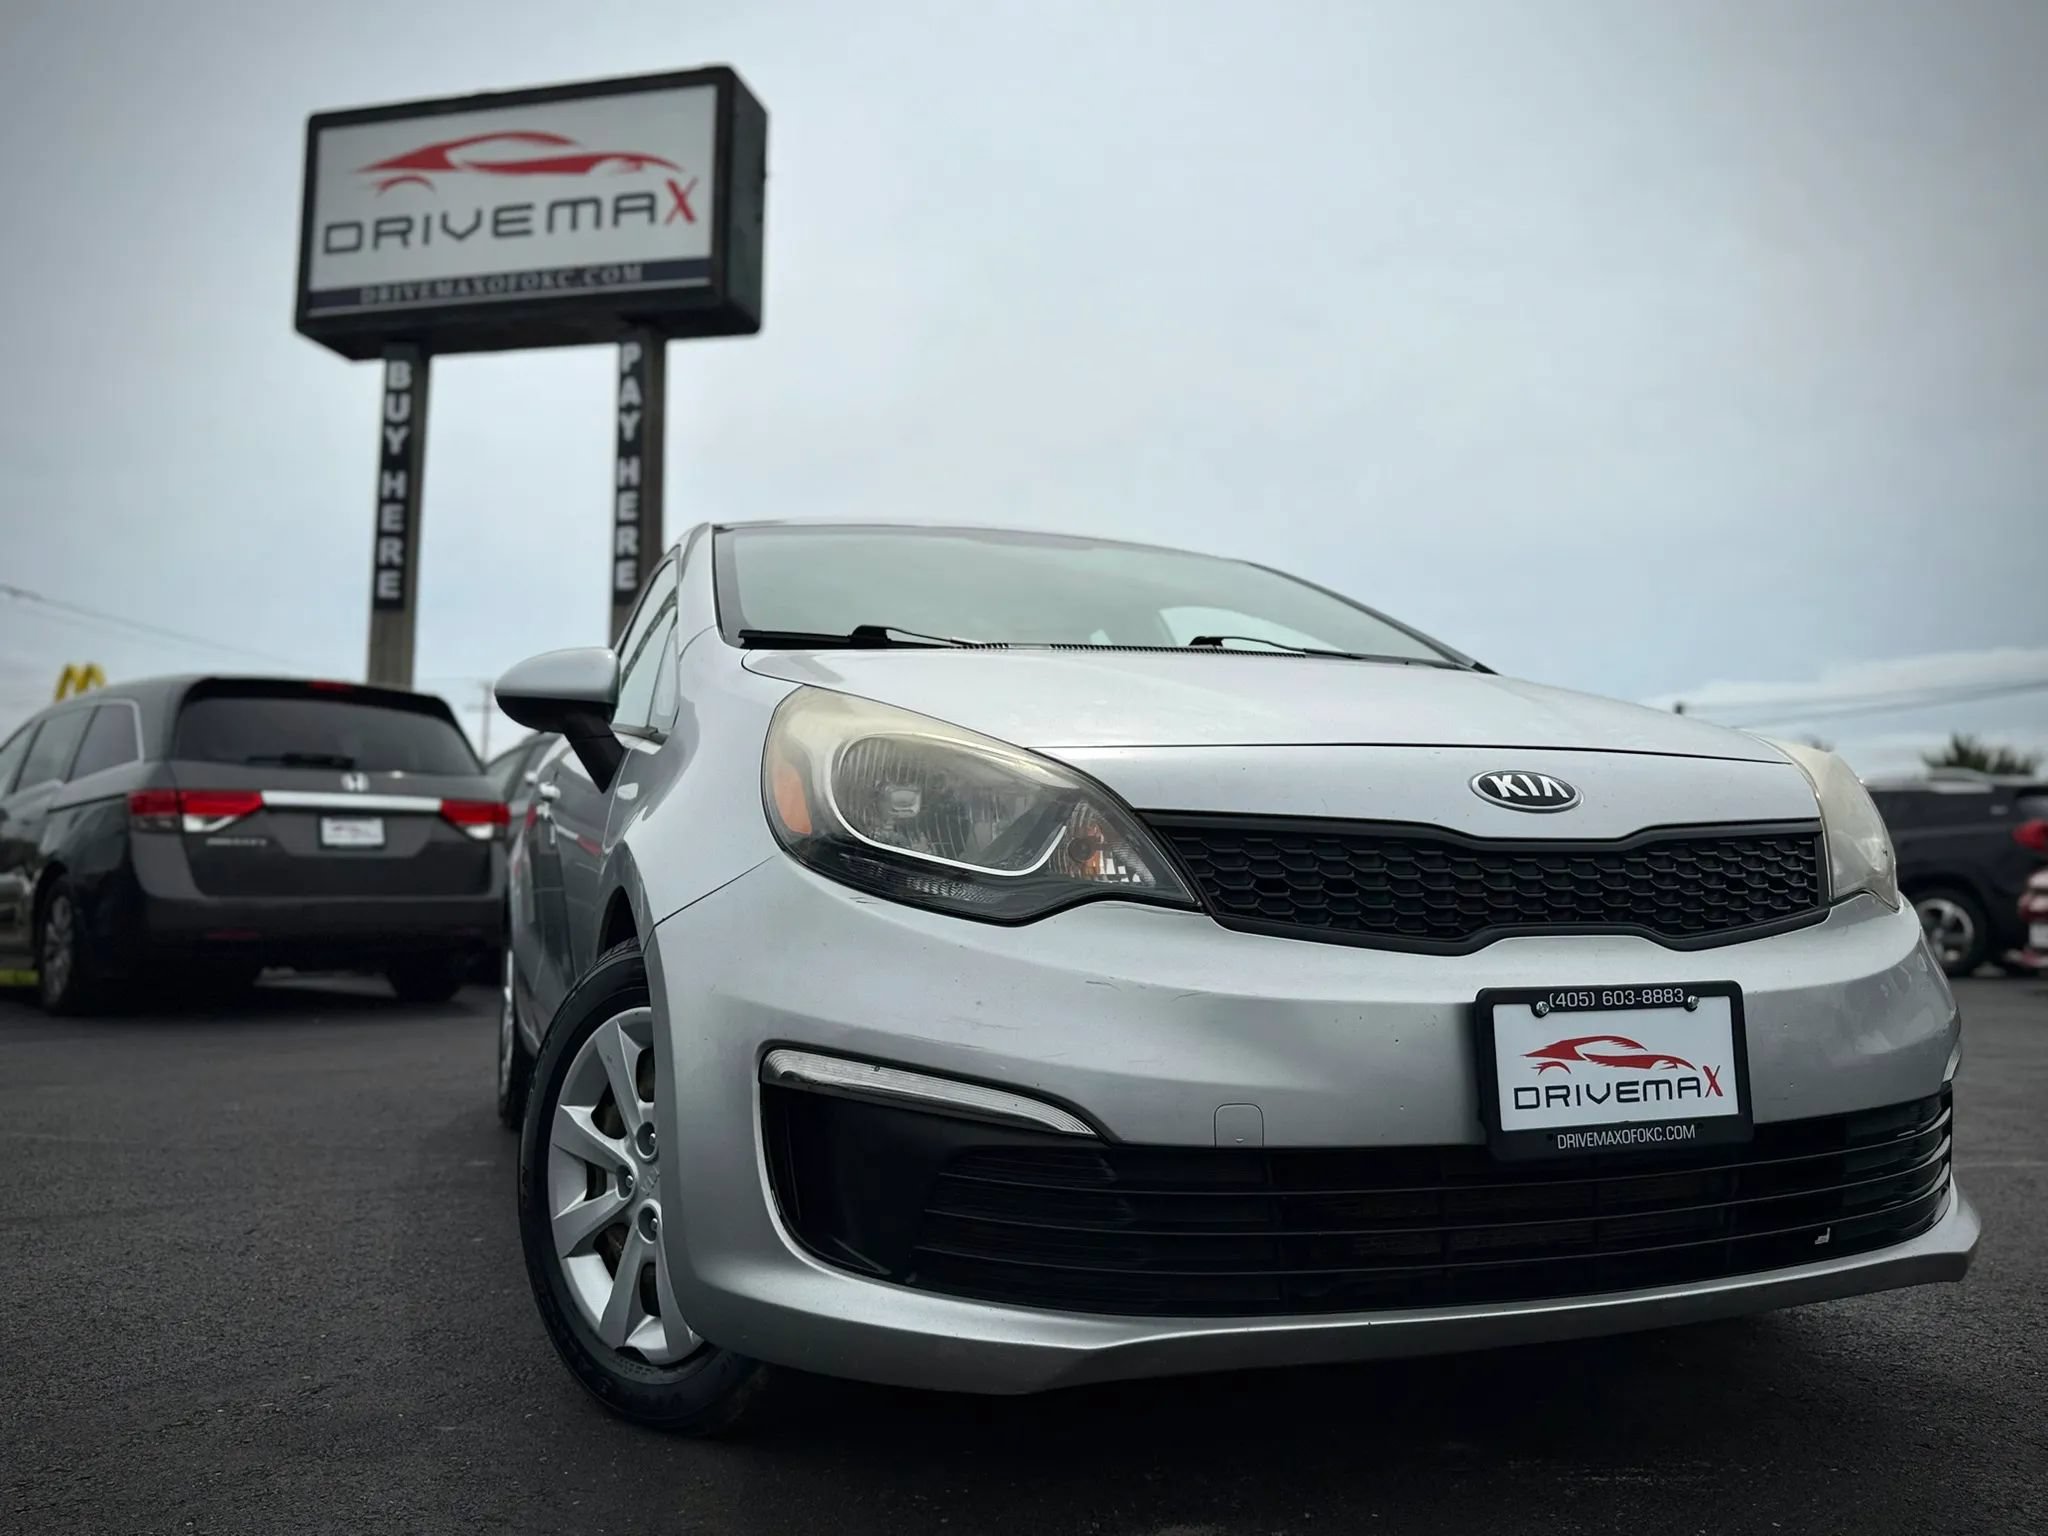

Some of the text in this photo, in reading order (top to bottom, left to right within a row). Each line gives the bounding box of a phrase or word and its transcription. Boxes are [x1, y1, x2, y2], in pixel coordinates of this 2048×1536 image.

[323, 177, 698, 255] DRIVEMAX
[376, 359, 411, 599] BUY HERE
[615, 342, 642, 591] PAY HERE
[1487, 774, 1570, 798] KIA
[1549, 988, 1684, 1008] (405) 603-8883
[1513, 1065, 1724, 1110] DRIVEMAX
[1557, 1124, 1696, 1150] DRIVEMAXOFOKC.COM
